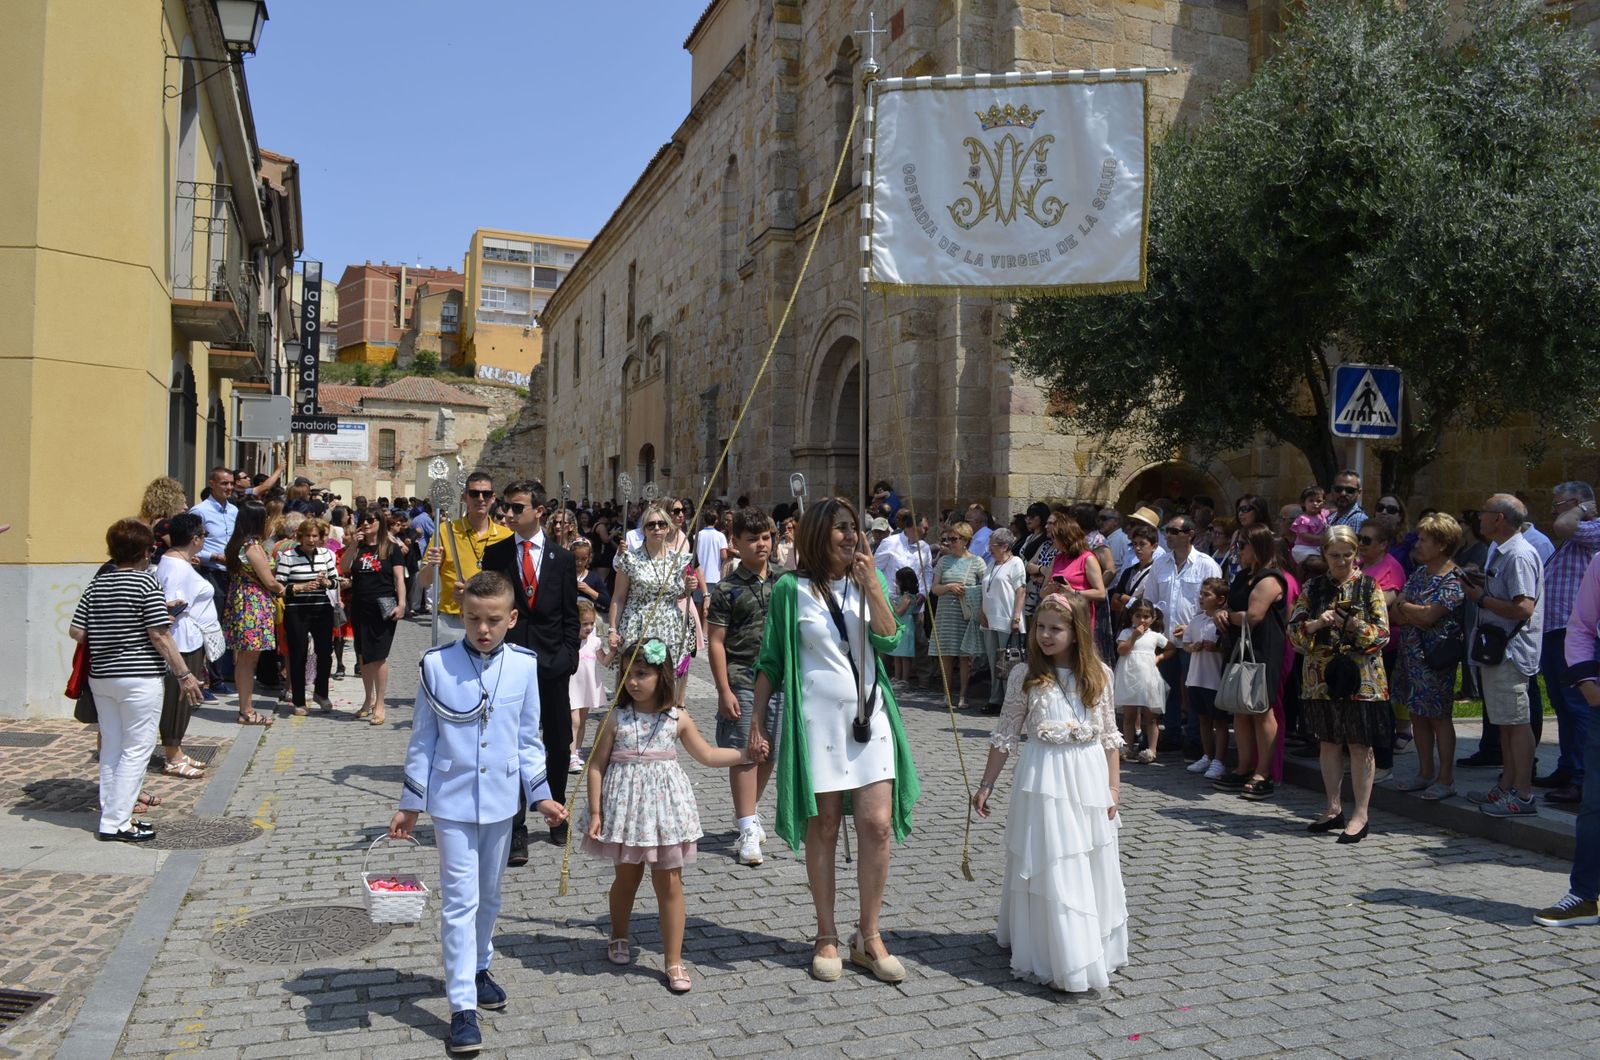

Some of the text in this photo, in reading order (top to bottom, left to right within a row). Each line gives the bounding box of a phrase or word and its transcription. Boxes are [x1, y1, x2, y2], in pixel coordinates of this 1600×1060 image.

[902, 157, 1118, 269] COFRADIA DE LA VIRGEN DE LA SALUD
[303, 287, 319, 415] la soledad
[291, 420, 337, 431] anatorio
